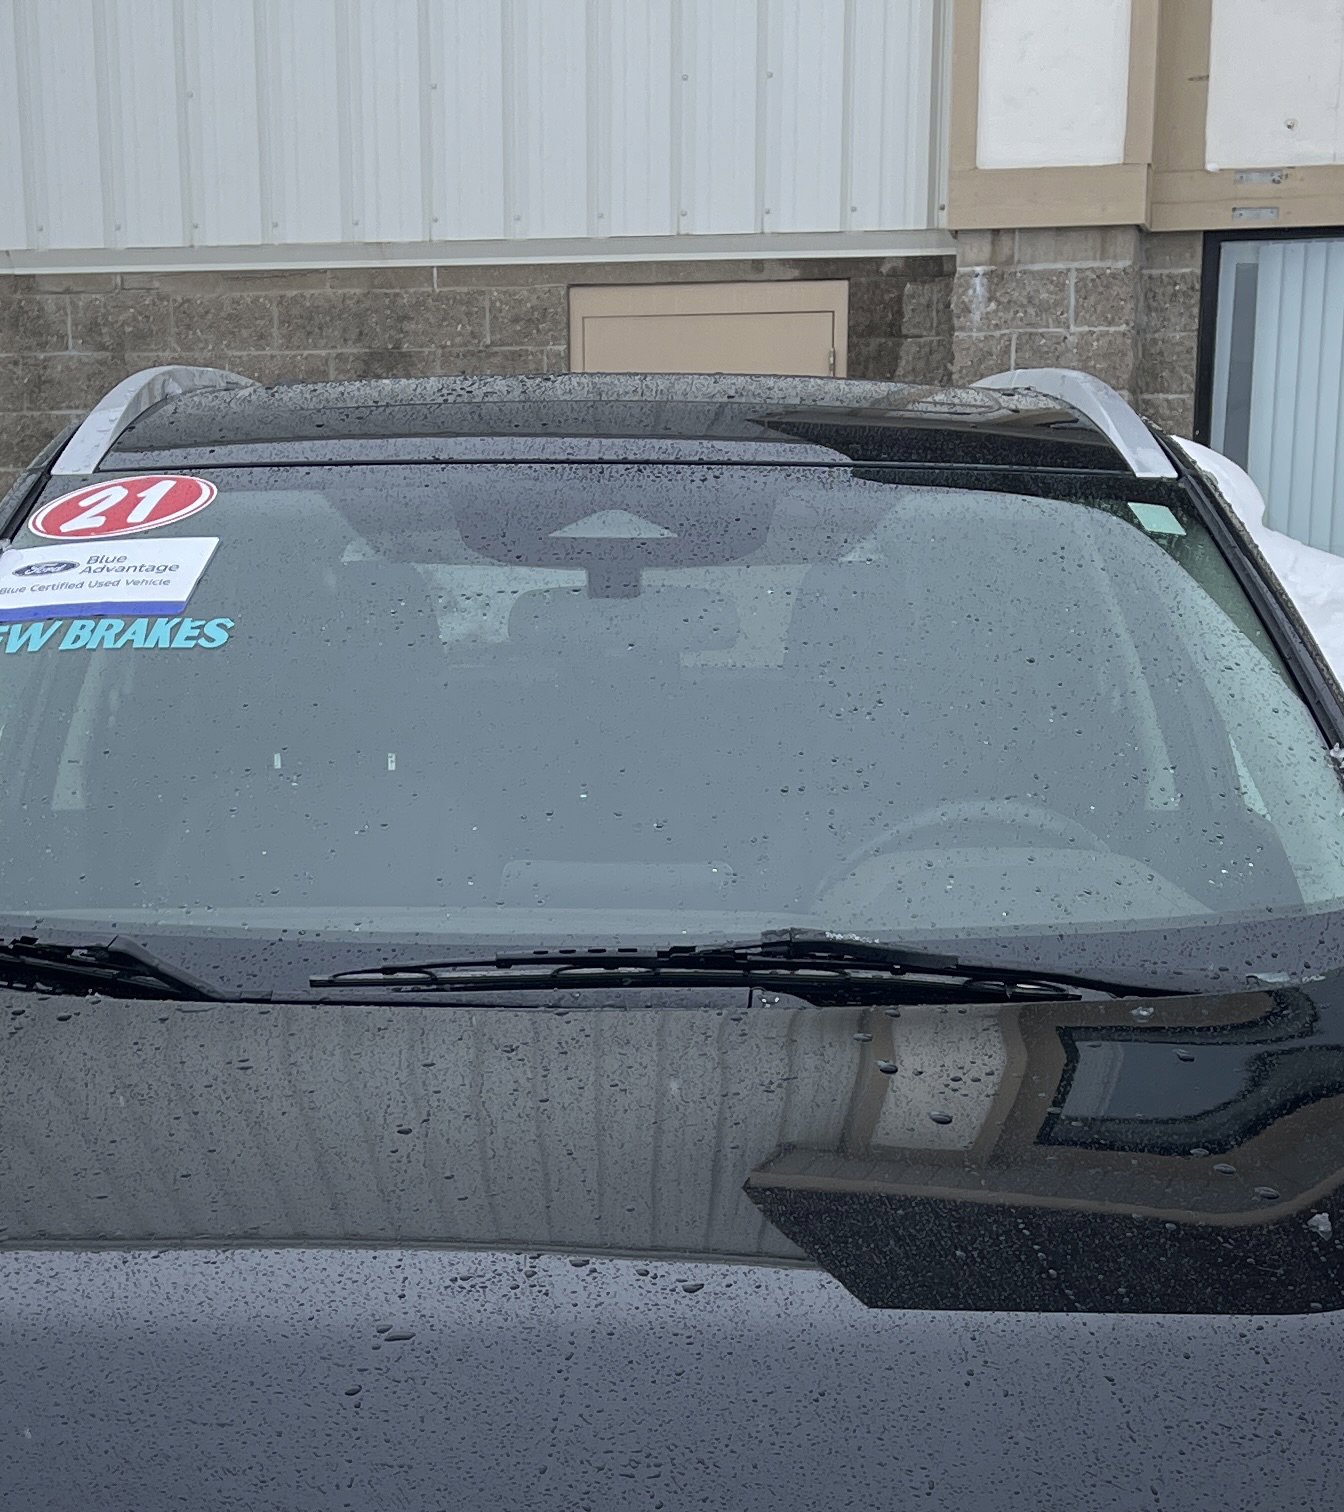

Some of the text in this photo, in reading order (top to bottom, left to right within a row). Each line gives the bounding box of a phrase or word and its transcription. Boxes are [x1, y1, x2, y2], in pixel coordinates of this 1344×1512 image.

[60, 480, 176, 532] 21
[86, 555, 127, 564] Blue
[25, 563, 67, 575] Ford
[79, 563, 180, 575] Advantage
[30, 580, 85, 593] Certified
[88, 579, 121, 588] Used
[125, 578, 171, 587] Vehicle
[59, 617, 235, 650] BRAKES
